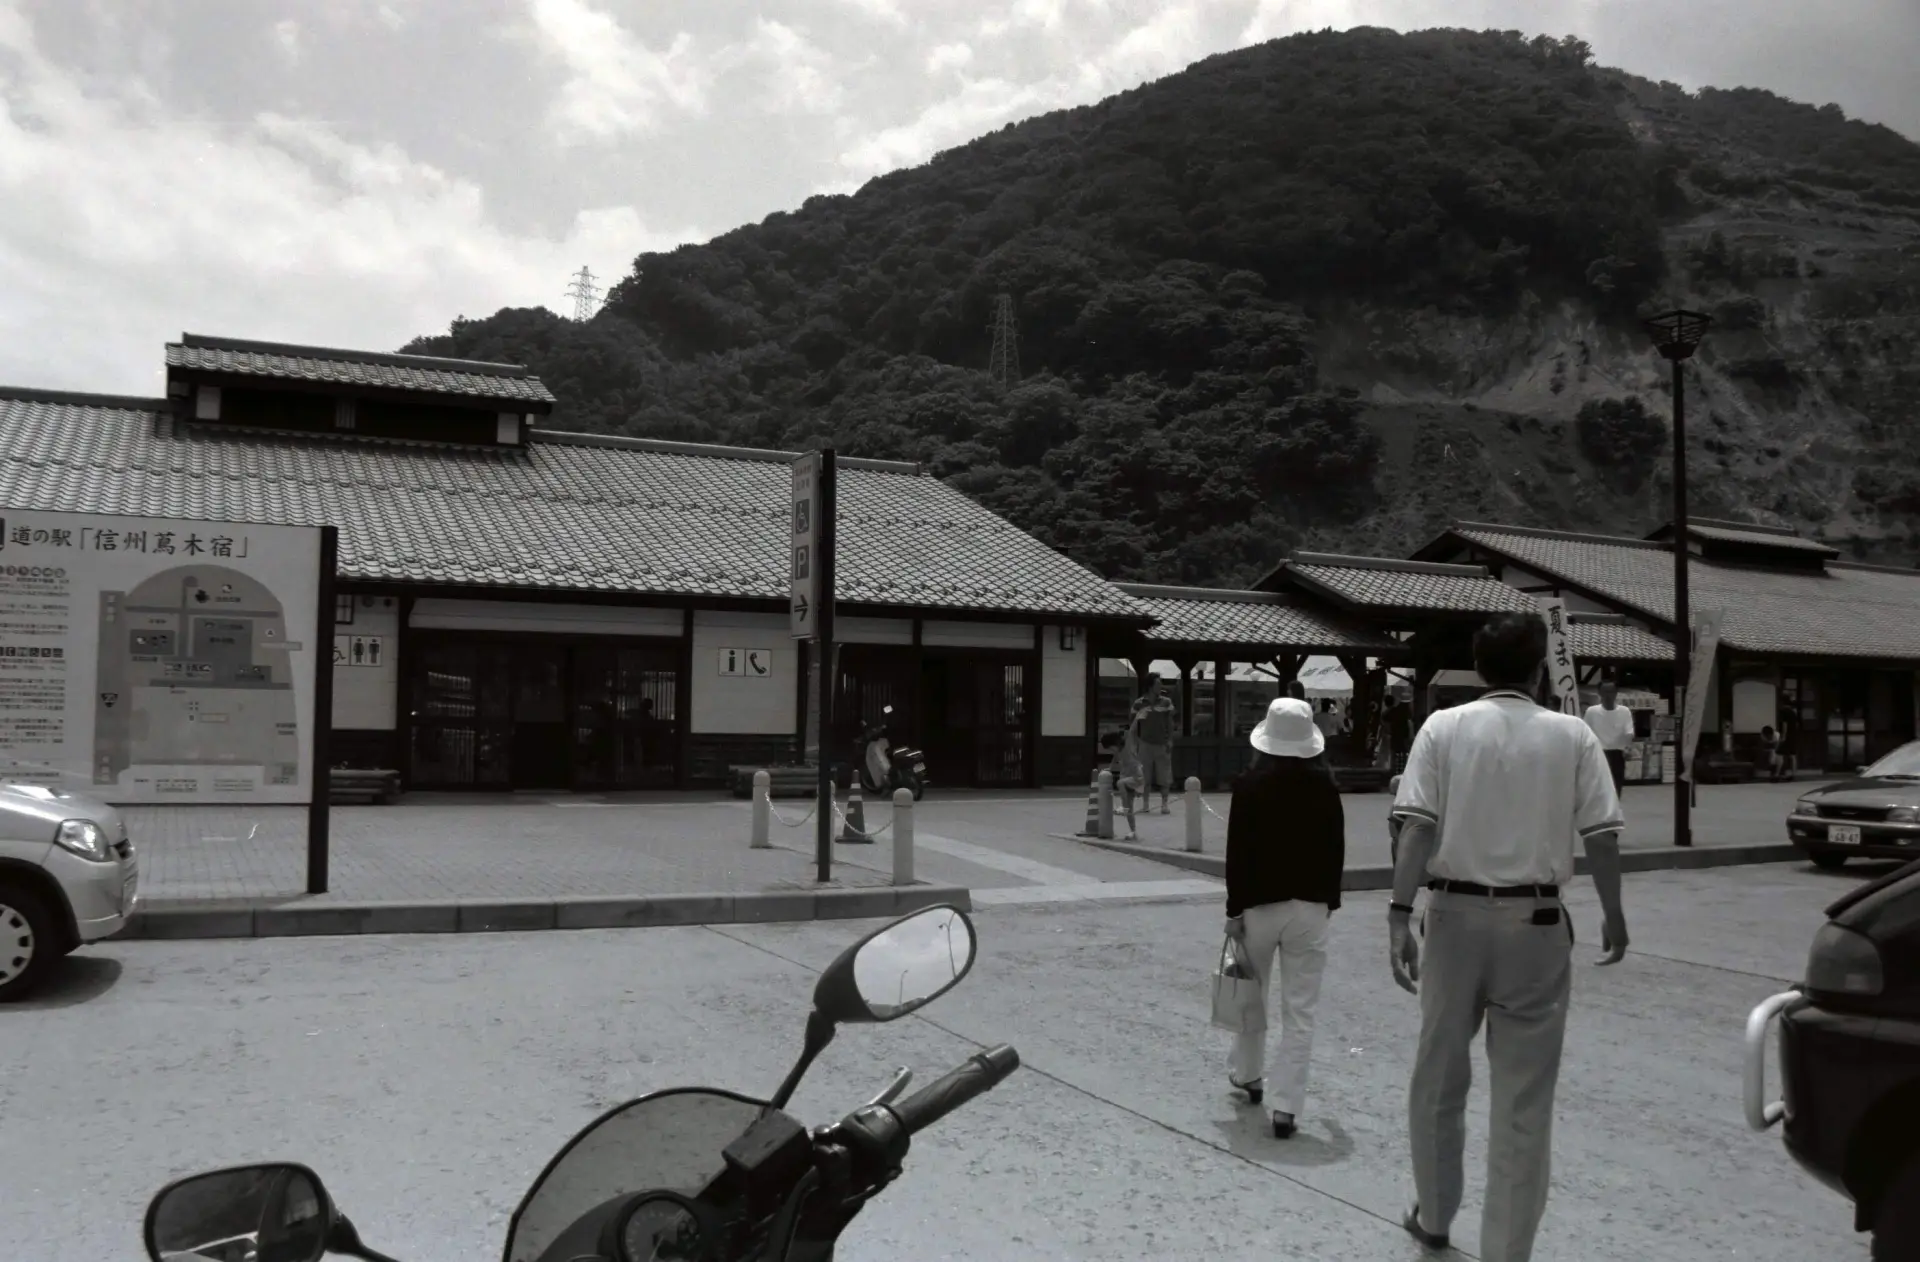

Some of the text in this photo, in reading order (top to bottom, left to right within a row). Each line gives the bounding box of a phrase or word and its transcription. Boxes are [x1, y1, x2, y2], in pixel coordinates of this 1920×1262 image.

[10, 527, 248, 558] 道の駅「信州蔦木宿」
[1548, 606, 1576, 716] 夏まつり
